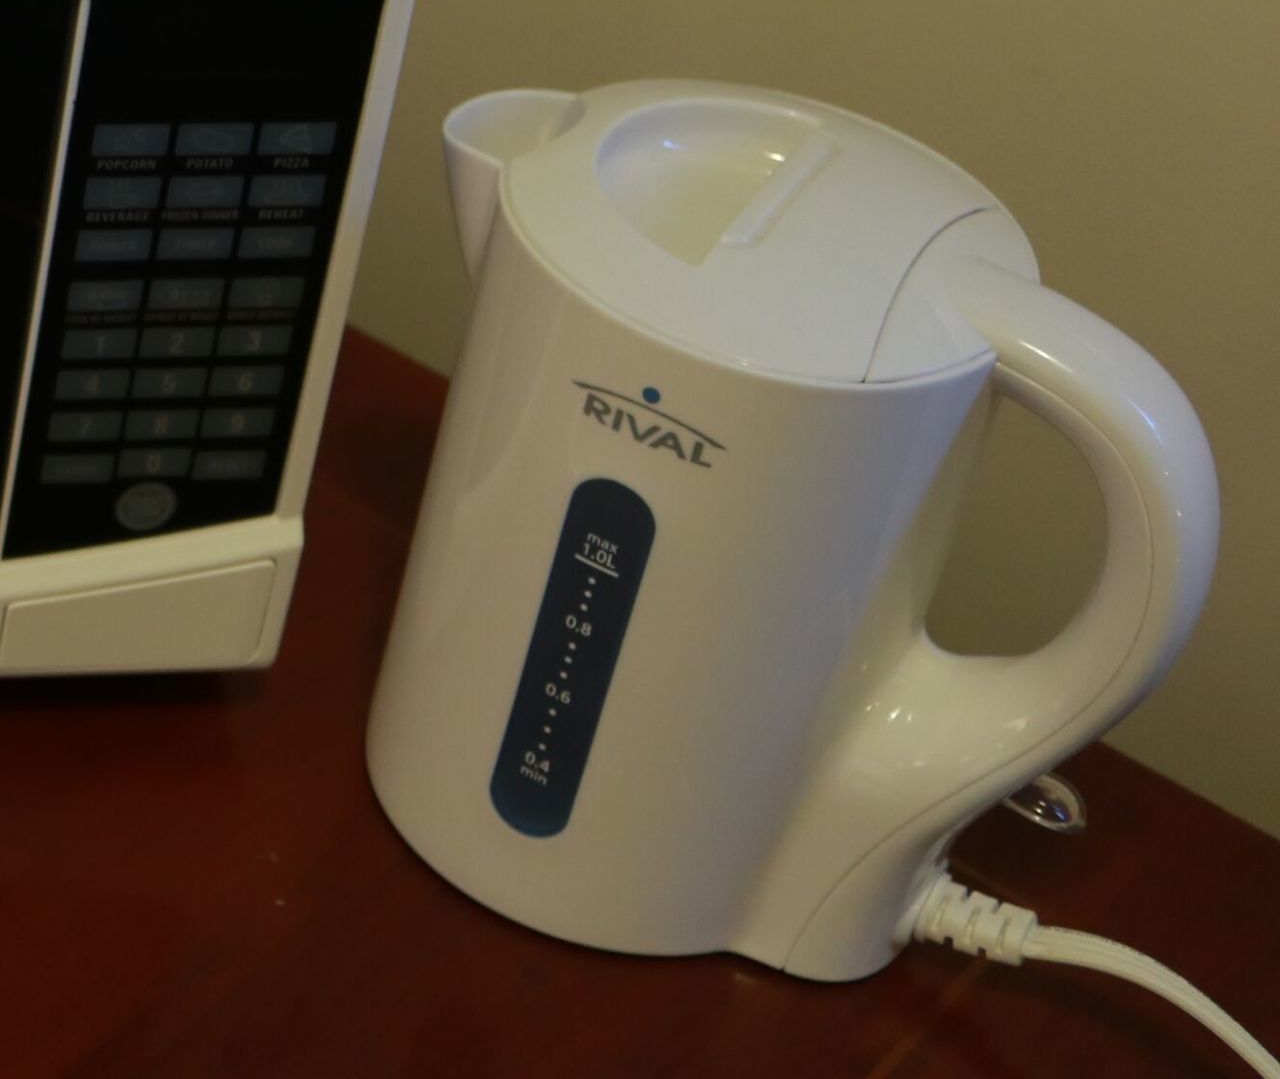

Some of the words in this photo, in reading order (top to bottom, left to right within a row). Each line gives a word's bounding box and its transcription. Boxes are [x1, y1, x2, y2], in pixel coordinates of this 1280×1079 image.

[96, 158, 157, 171] POPCORN
[185, 157, 235, 170] POTATO
[273, 156, 310, 169] PIZZA
[583, 393, 712, 469] RIVAL
[587, 532, 619, 554] max
[582, 542, 617, 570] 1.0L
[565, 614, 592, 637] 0.8
[545, 682, 571, 705] 0.6
[524, 750, 551, 773] 0.4
[520, 765, 548, 786] min
